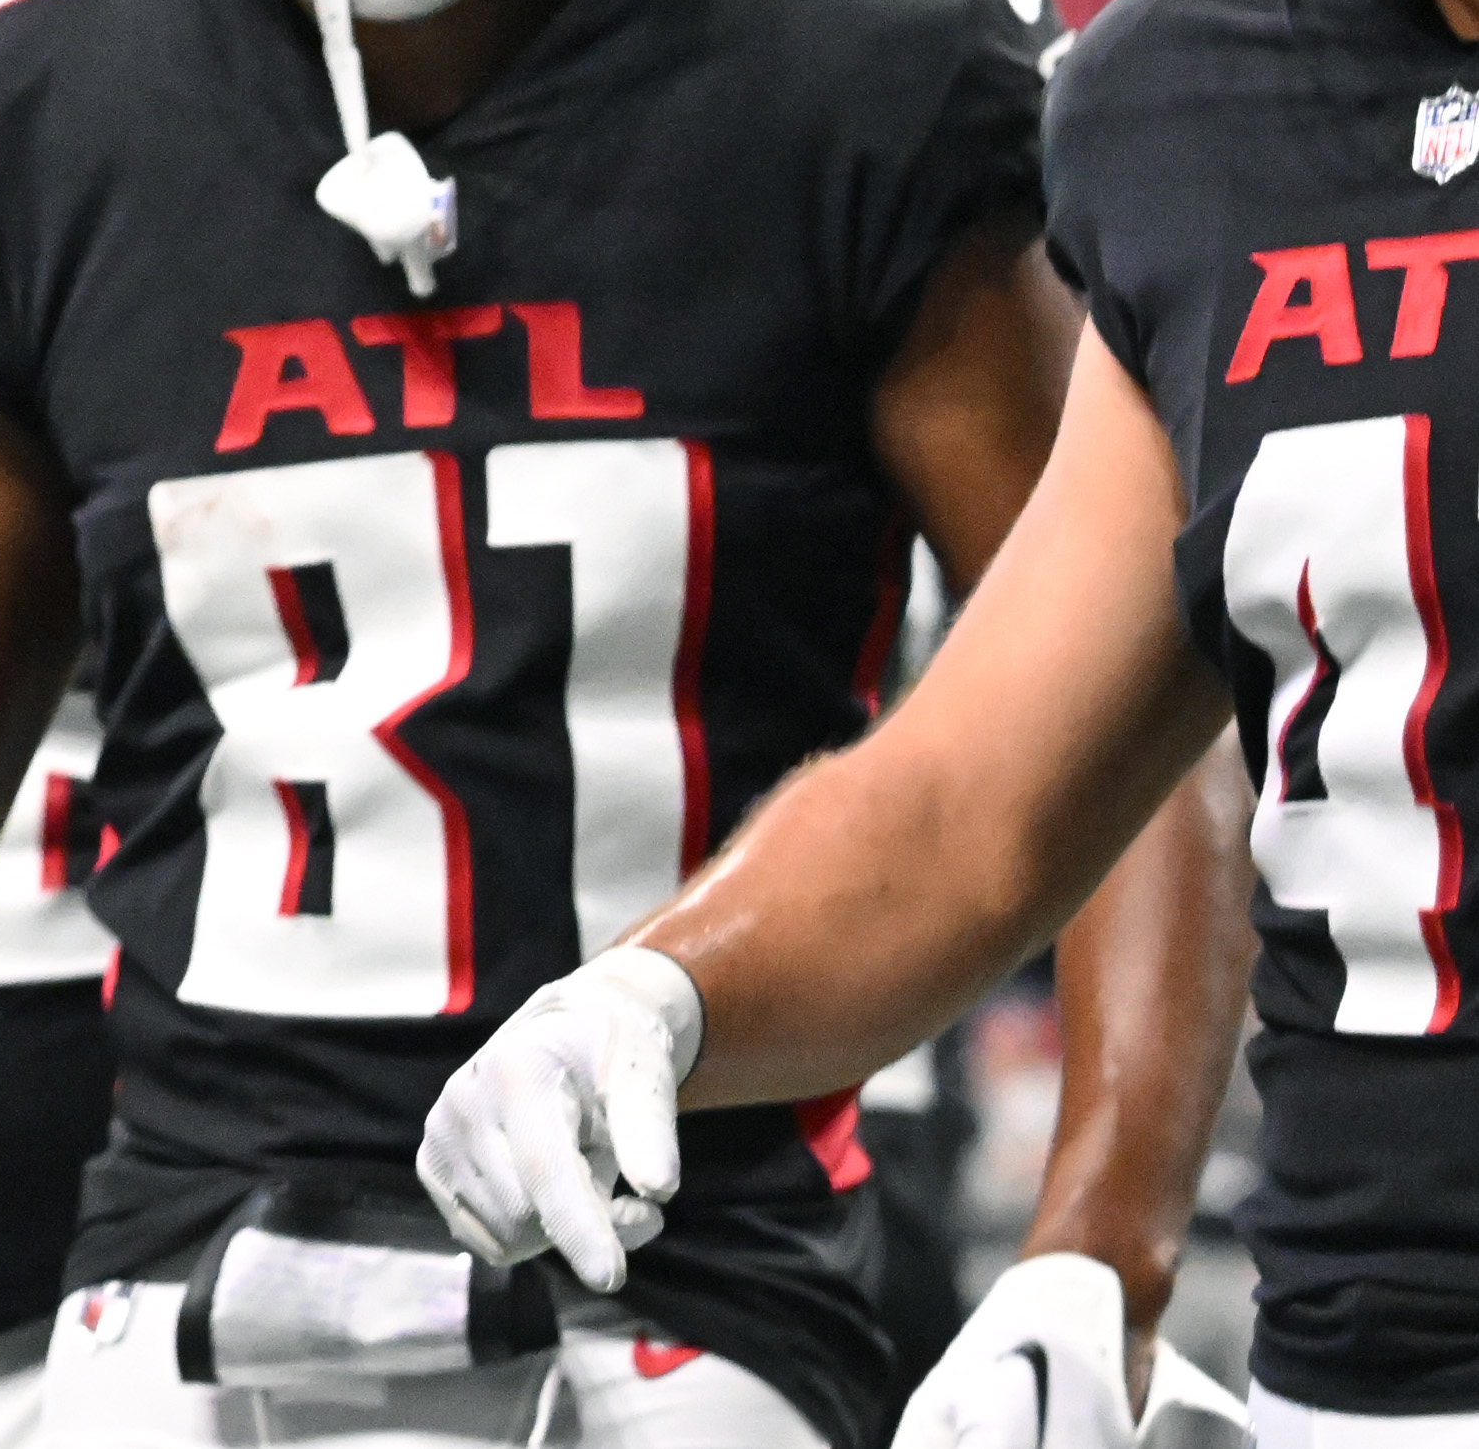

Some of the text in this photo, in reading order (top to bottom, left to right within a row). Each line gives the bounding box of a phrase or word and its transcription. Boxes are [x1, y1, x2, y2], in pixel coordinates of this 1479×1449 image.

[214, 301, 645, 453] ATL
[148, 439, 714, 1018] 81
[1223, 414, 1479, 1035] 4
